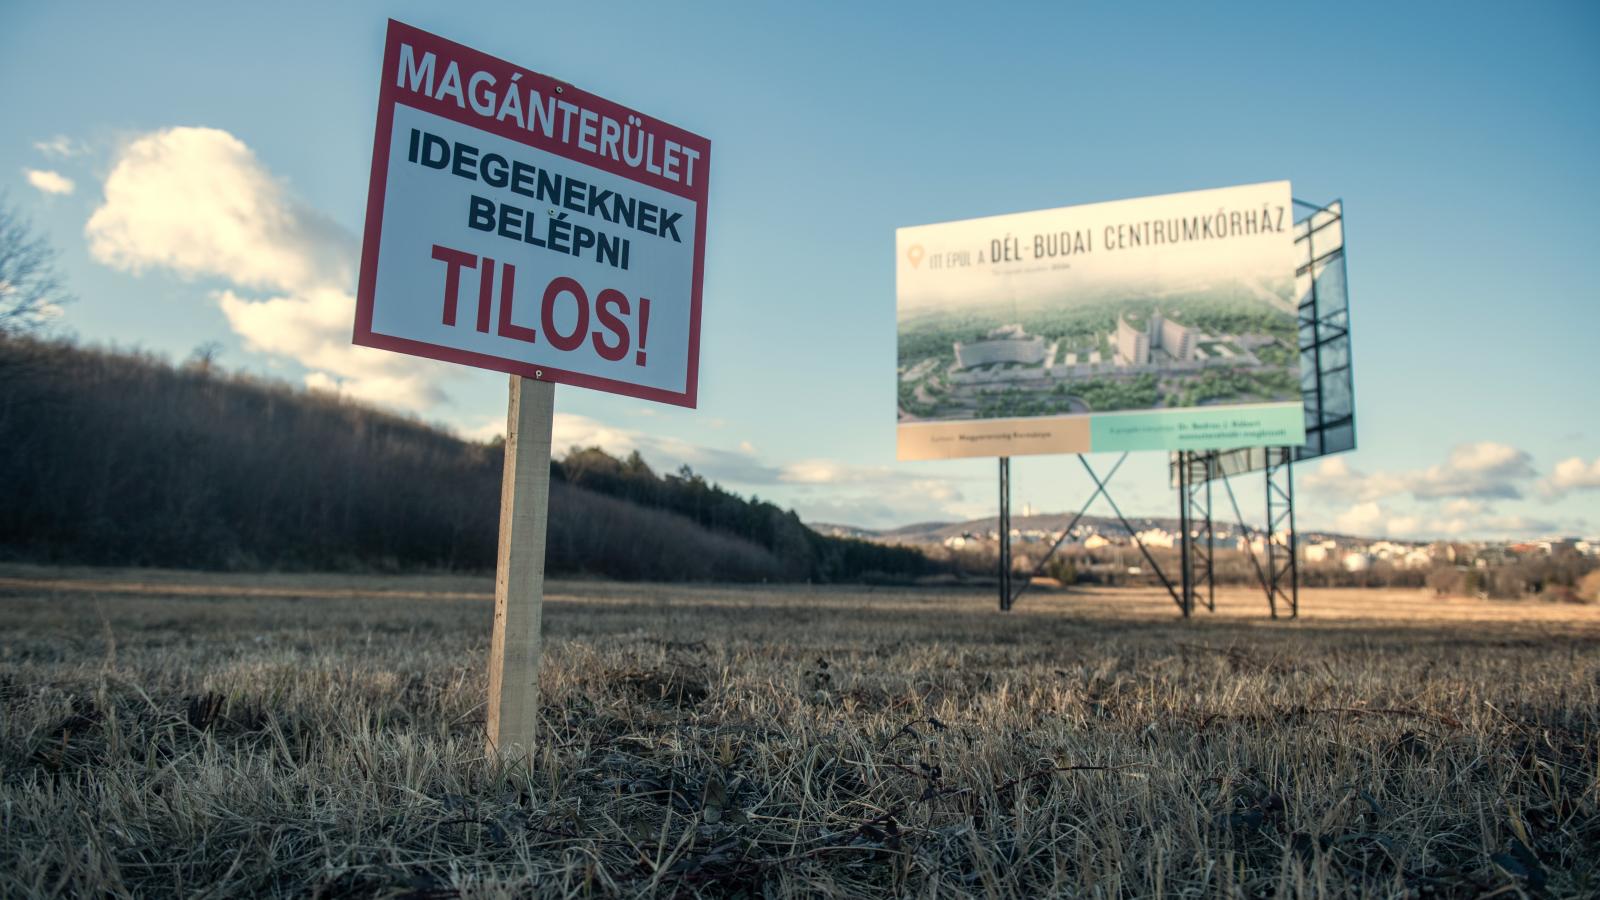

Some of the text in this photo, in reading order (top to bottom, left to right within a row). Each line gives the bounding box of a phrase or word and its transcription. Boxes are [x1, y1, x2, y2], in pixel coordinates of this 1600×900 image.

[396, 43, 700, 187] MAGÁNTERÜLET
[408, 128, 683, 243] IDEGENEKNEK
[468, 194, 630, 270] BELÉPNI
[930, 253, 943, 270] ITT
[977, 250, 986, 265] A
[991, 228, 1092, 264] DÉL-BUDAI
[1104, 202, 1285, 251] CENTRUMKÓRHÁZ
[431, 243, 651, 367] TILOS!
